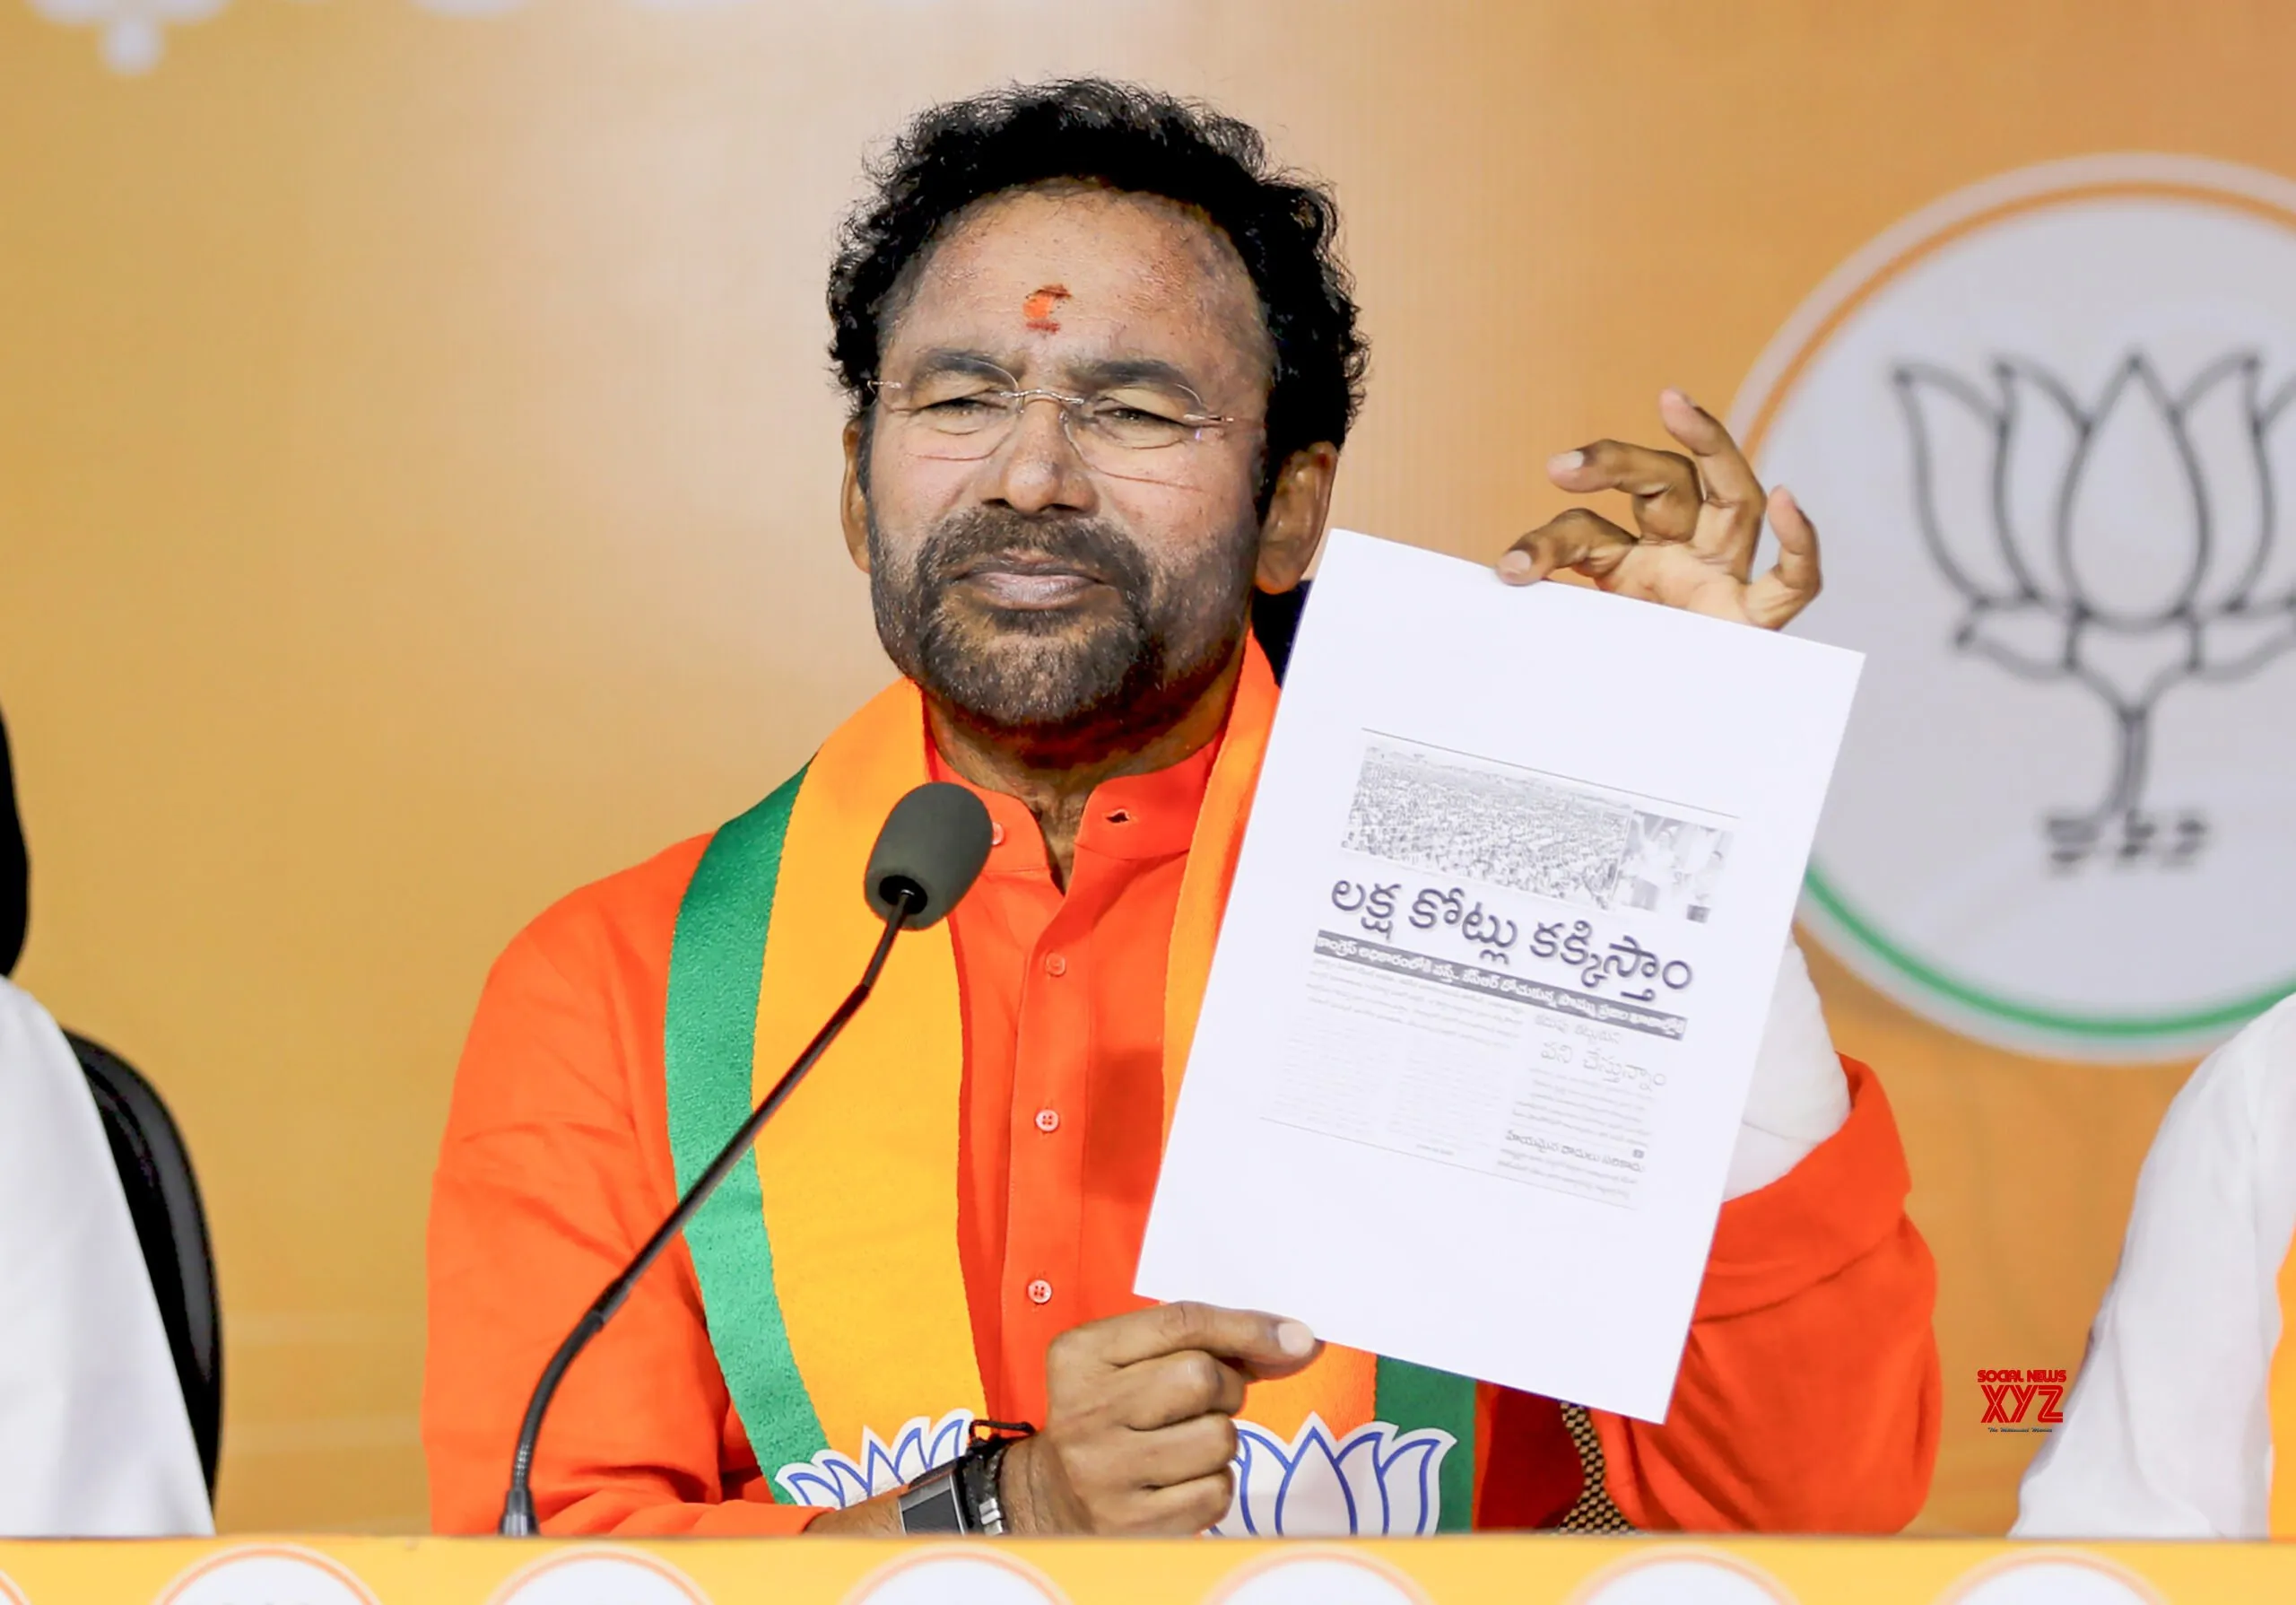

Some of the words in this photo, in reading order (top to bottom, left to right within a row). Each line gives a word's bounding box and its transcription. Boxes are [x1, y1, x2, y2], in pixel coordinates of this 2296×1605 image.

[1332, 880, 1401, 940] లక్ష
[1408, 888, 1518, 964] కోట్లు
[1529, 920, 1692, 1002] కక్కిస్తాం
